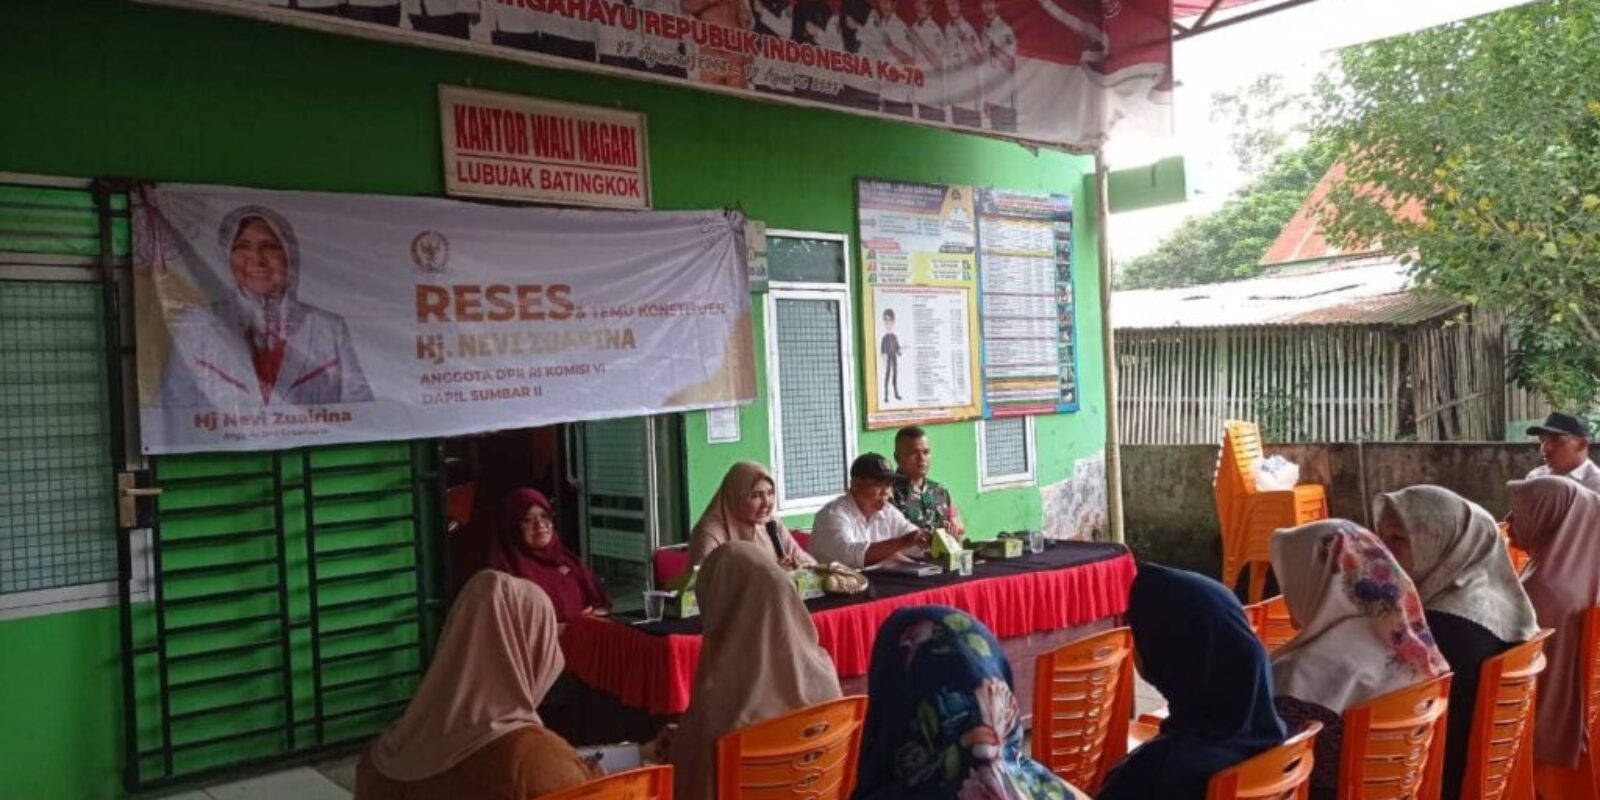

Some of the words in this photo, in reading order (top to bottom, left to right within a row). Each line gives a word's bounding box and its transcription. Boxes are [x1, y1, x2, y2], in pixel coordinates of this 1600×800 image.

[644, 9, 760, 57] REPUBLIK
[763, 36, 873, 79] INDONESIA
[454, 104, 529, 156] KANTOR
[531, 113, 576, 161] WALI
[578, 120, 638, 168] NAGARI
[457, 161, 535, 189] LUBUAK
[540, 169, 641, 198] BATINGKOK
[415, 284, 574, 323] RESES
[593, 304, 634, 319] TEMU
[420, 369, 493, 384] ANGGOTA
[496, 367, 525, 380] DPR
[529, 366, 542, 379] RI
[545, 363, 590, 378] KOMISI
[422, 390, 468, 405] DAPIL
[470, 387, 531, 401] SUMBAR
[194, 410, 218, 431] Hj
[223, 410, 267, 427] Nevi
[272, 407, 352, 425] Zuairina
